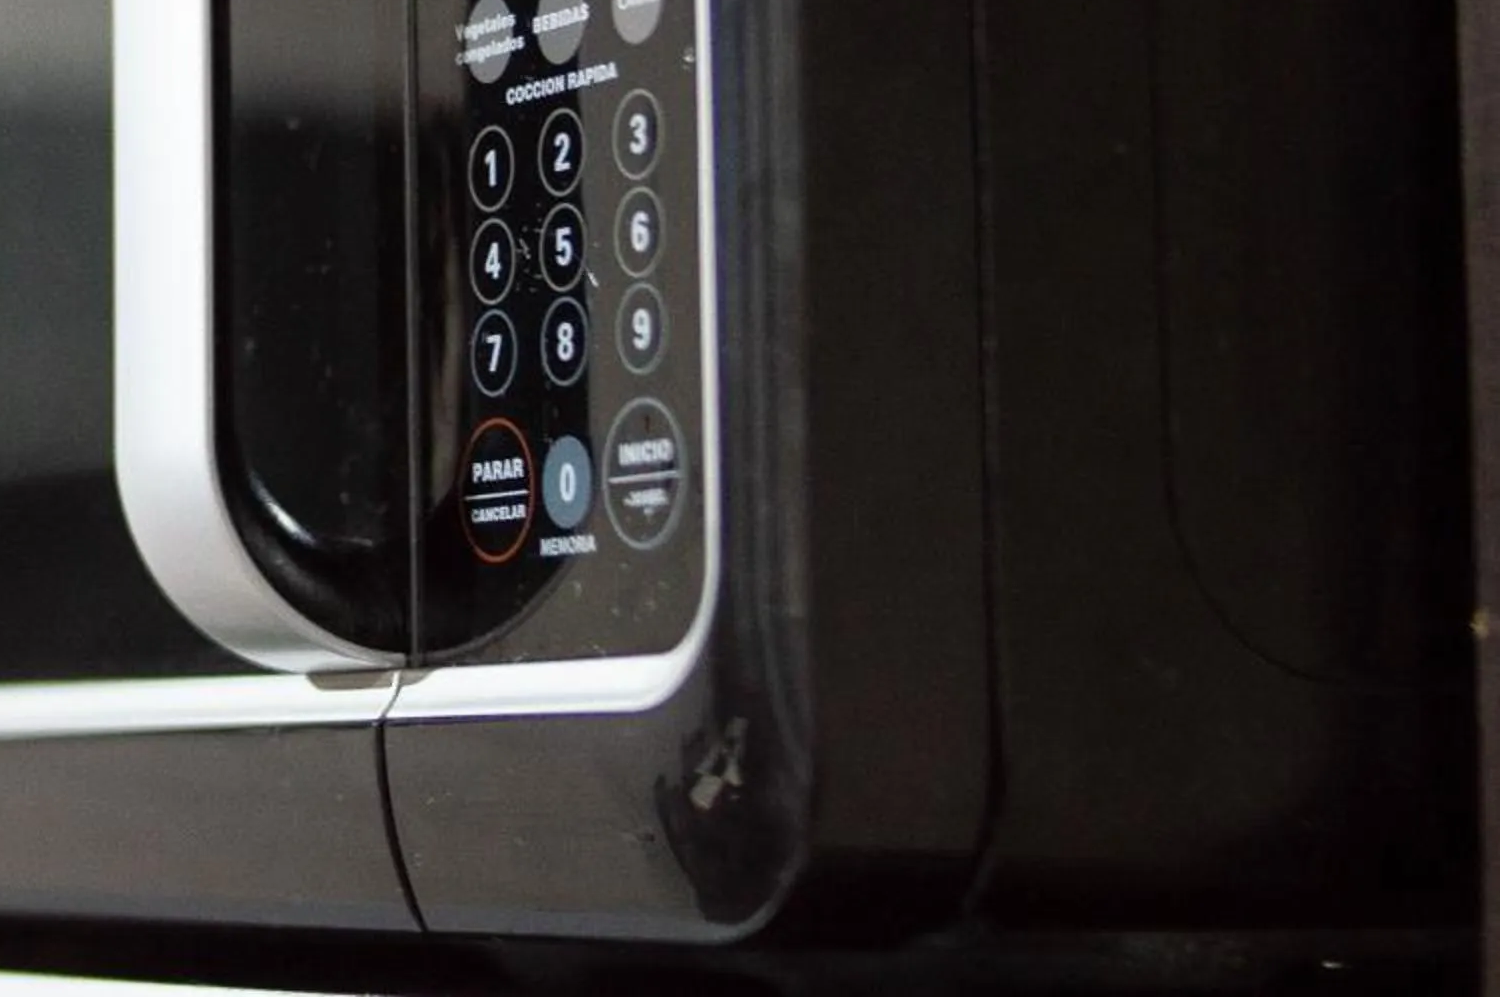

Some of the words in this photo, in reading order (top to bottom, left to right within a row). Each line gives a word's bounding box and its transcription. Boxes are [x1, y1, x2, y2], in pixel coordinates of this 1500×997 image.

[455, 13, 516, 42] Vegetales
[532, 3, 590, 34] BEBIDAS
[455, 35, 525, 66] congelados
[505, 77, 565, 106] COCCION
[567, 61, 619, 90] RAPIDA
[553, 132, 571, 172] 2
[629, 113, 648, 154] 3
[484, 149, 497, 187] 1
[555, 227, 572, 266] 5
[630, 211, 650, 252] 6
[484, 241, 502, 279] 4
[557, 322, 574, 361] 8
[632, 308, 651, 351] 9
[486, 334, 502, 372] 7
[472, 457, 524, 483] PARAR
[618, 438, 674, 466] INICIO
[559, 463, 575, 502] 0
[471, 504, 527, 523] CANCELAR
[539, 534, 597, 556] MEMORIA
